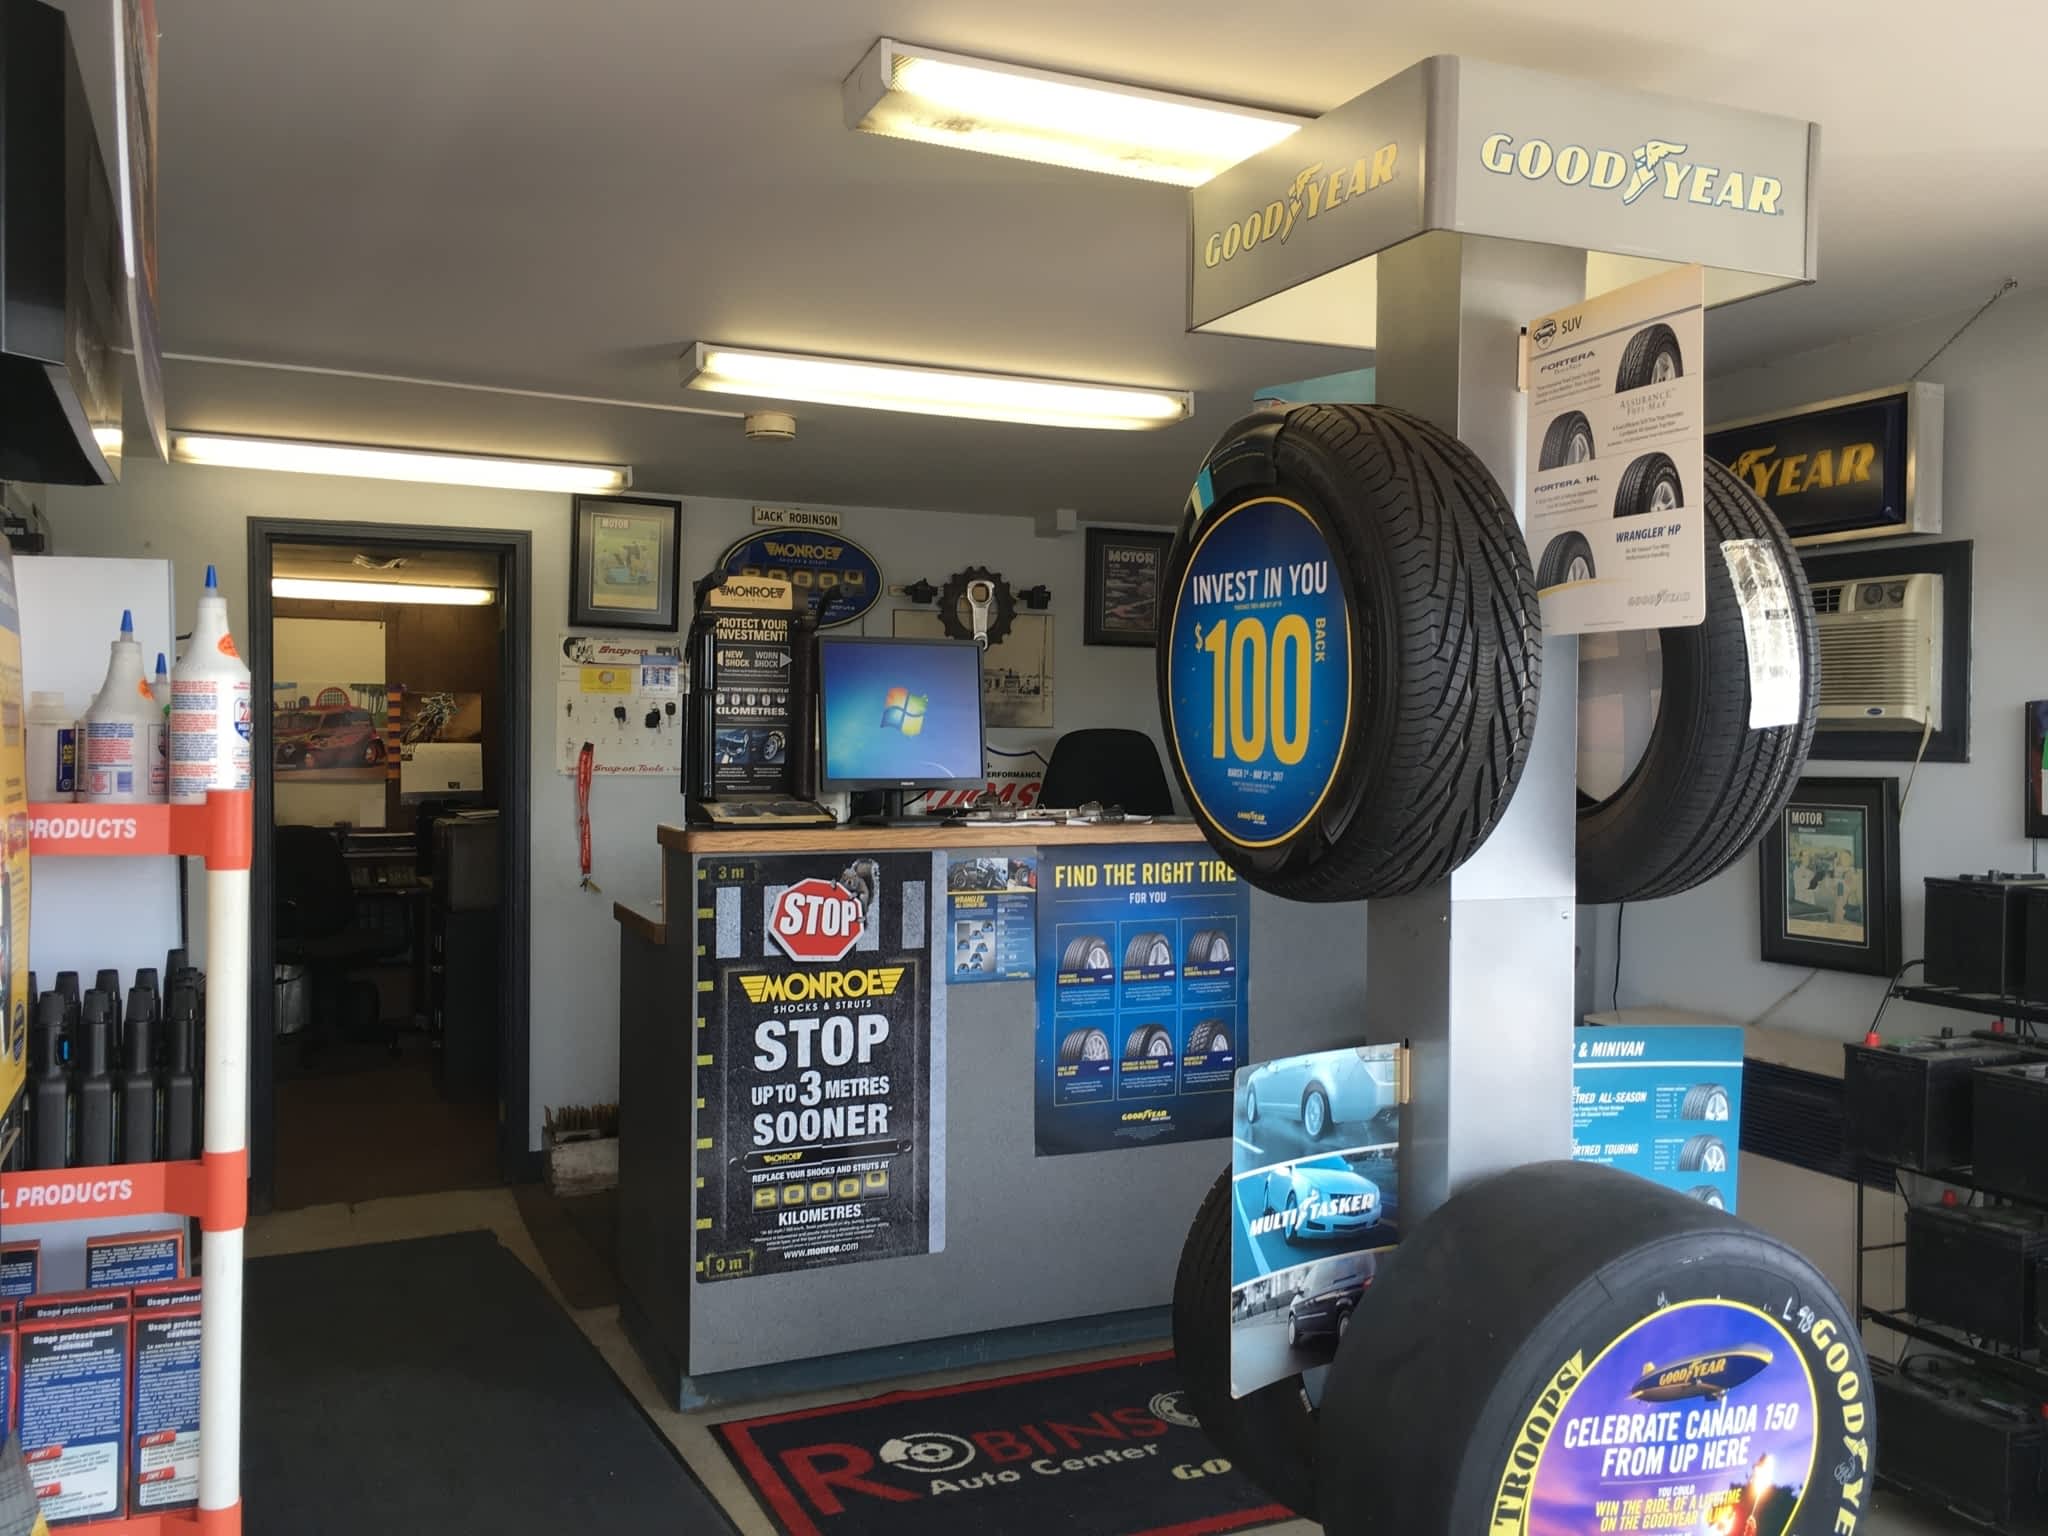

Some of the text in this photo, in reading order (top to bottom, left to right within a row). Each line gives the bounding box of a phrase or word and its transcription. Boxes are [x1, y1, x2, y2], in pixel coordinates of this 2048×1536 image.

[1481, 133, 1784, 216] GOODYEAR
[1204, 142, 1399, 268] GOODYEAR
[1561, 316, 1582, 334] SUV
[1540, 350, 1596, 373] FORTERA
[1534, 478, 1580, 494] FORTERA
[789, 512, 838, 526] ROBINSON
[1616, 524, 1681, 543] WRANGLER HP
[770, 543, 838, 560] MONROE
[1108, 550, 1154, 564] MOTOR
[723, 585, 781, 598] MONROE
[1193, 561, 1328, 605] INVEST IN YOU
[716, 617, 788, 630] PROTECT YOUR
[1315, 617, 1326, 662] BACK
[725, 650, 744, 658] NEW
[1791, 811, 1823, 826] MOTOR
[718, 867, 728, 879] 3
[1055, 865, 1097, 888] FIND
[1104, 863, 1136, 886] THE
[1142, 861, 1194, 884] RIGHT
[1129, 891, 1166, 905] FOR YOU
[779, 892, 857, 936] STOP
[752, 968, 892, 1003] MONROE
[773, 1000, 872, 1014] SHOCKS & STRUTS
[754, 1014, 889, 1071] STOP
[1578, 1041, 1645, 1057] & MINIVAN
[751, 1070, 890, 1106] UP TO 3 METRES
[1599, 1091, 1647, 1103] ALL-SEASON
[1122, 1109, 1167, 1121] GOODYEAR
[752, 1161, 890, 1183] REPLACE YOUR SHOCKS AND STRUTS AT
[16, 1179, 132, 1207] PRODUCTS
[779, 1203, 862, 1226] KILOMETRES
[784, 1242, 859, 1260] www.monroe.com
[1659, 1358, 1727, 1386] GOODYEAR
[1564, 1403, 1799, 1449] CELEBRATE CANADA 150
[1495, 1366, 1578, 1527] TROOPS
[1601, 1436, 1750, 1478] FROM UP HERE
[930, 1440, 1158, 1495] Auto Center
[1658, 1484, 1695, 1497] YOU COULD
[1596, 1501, 1619, 1517] WIN
[1622, 1499, 1642, 1514] THE
[1645, 1497, 1670, 1513] RIDE
[1673, 1496, 1687, 1510] OF
[1689, 1495, 1697, 1509] A
[1601, 1516, 1617, 1532] ON
[1620, 1515, 1639, 1531] THE
[1642, 1511, 1698, 1528] GOODYEAR
